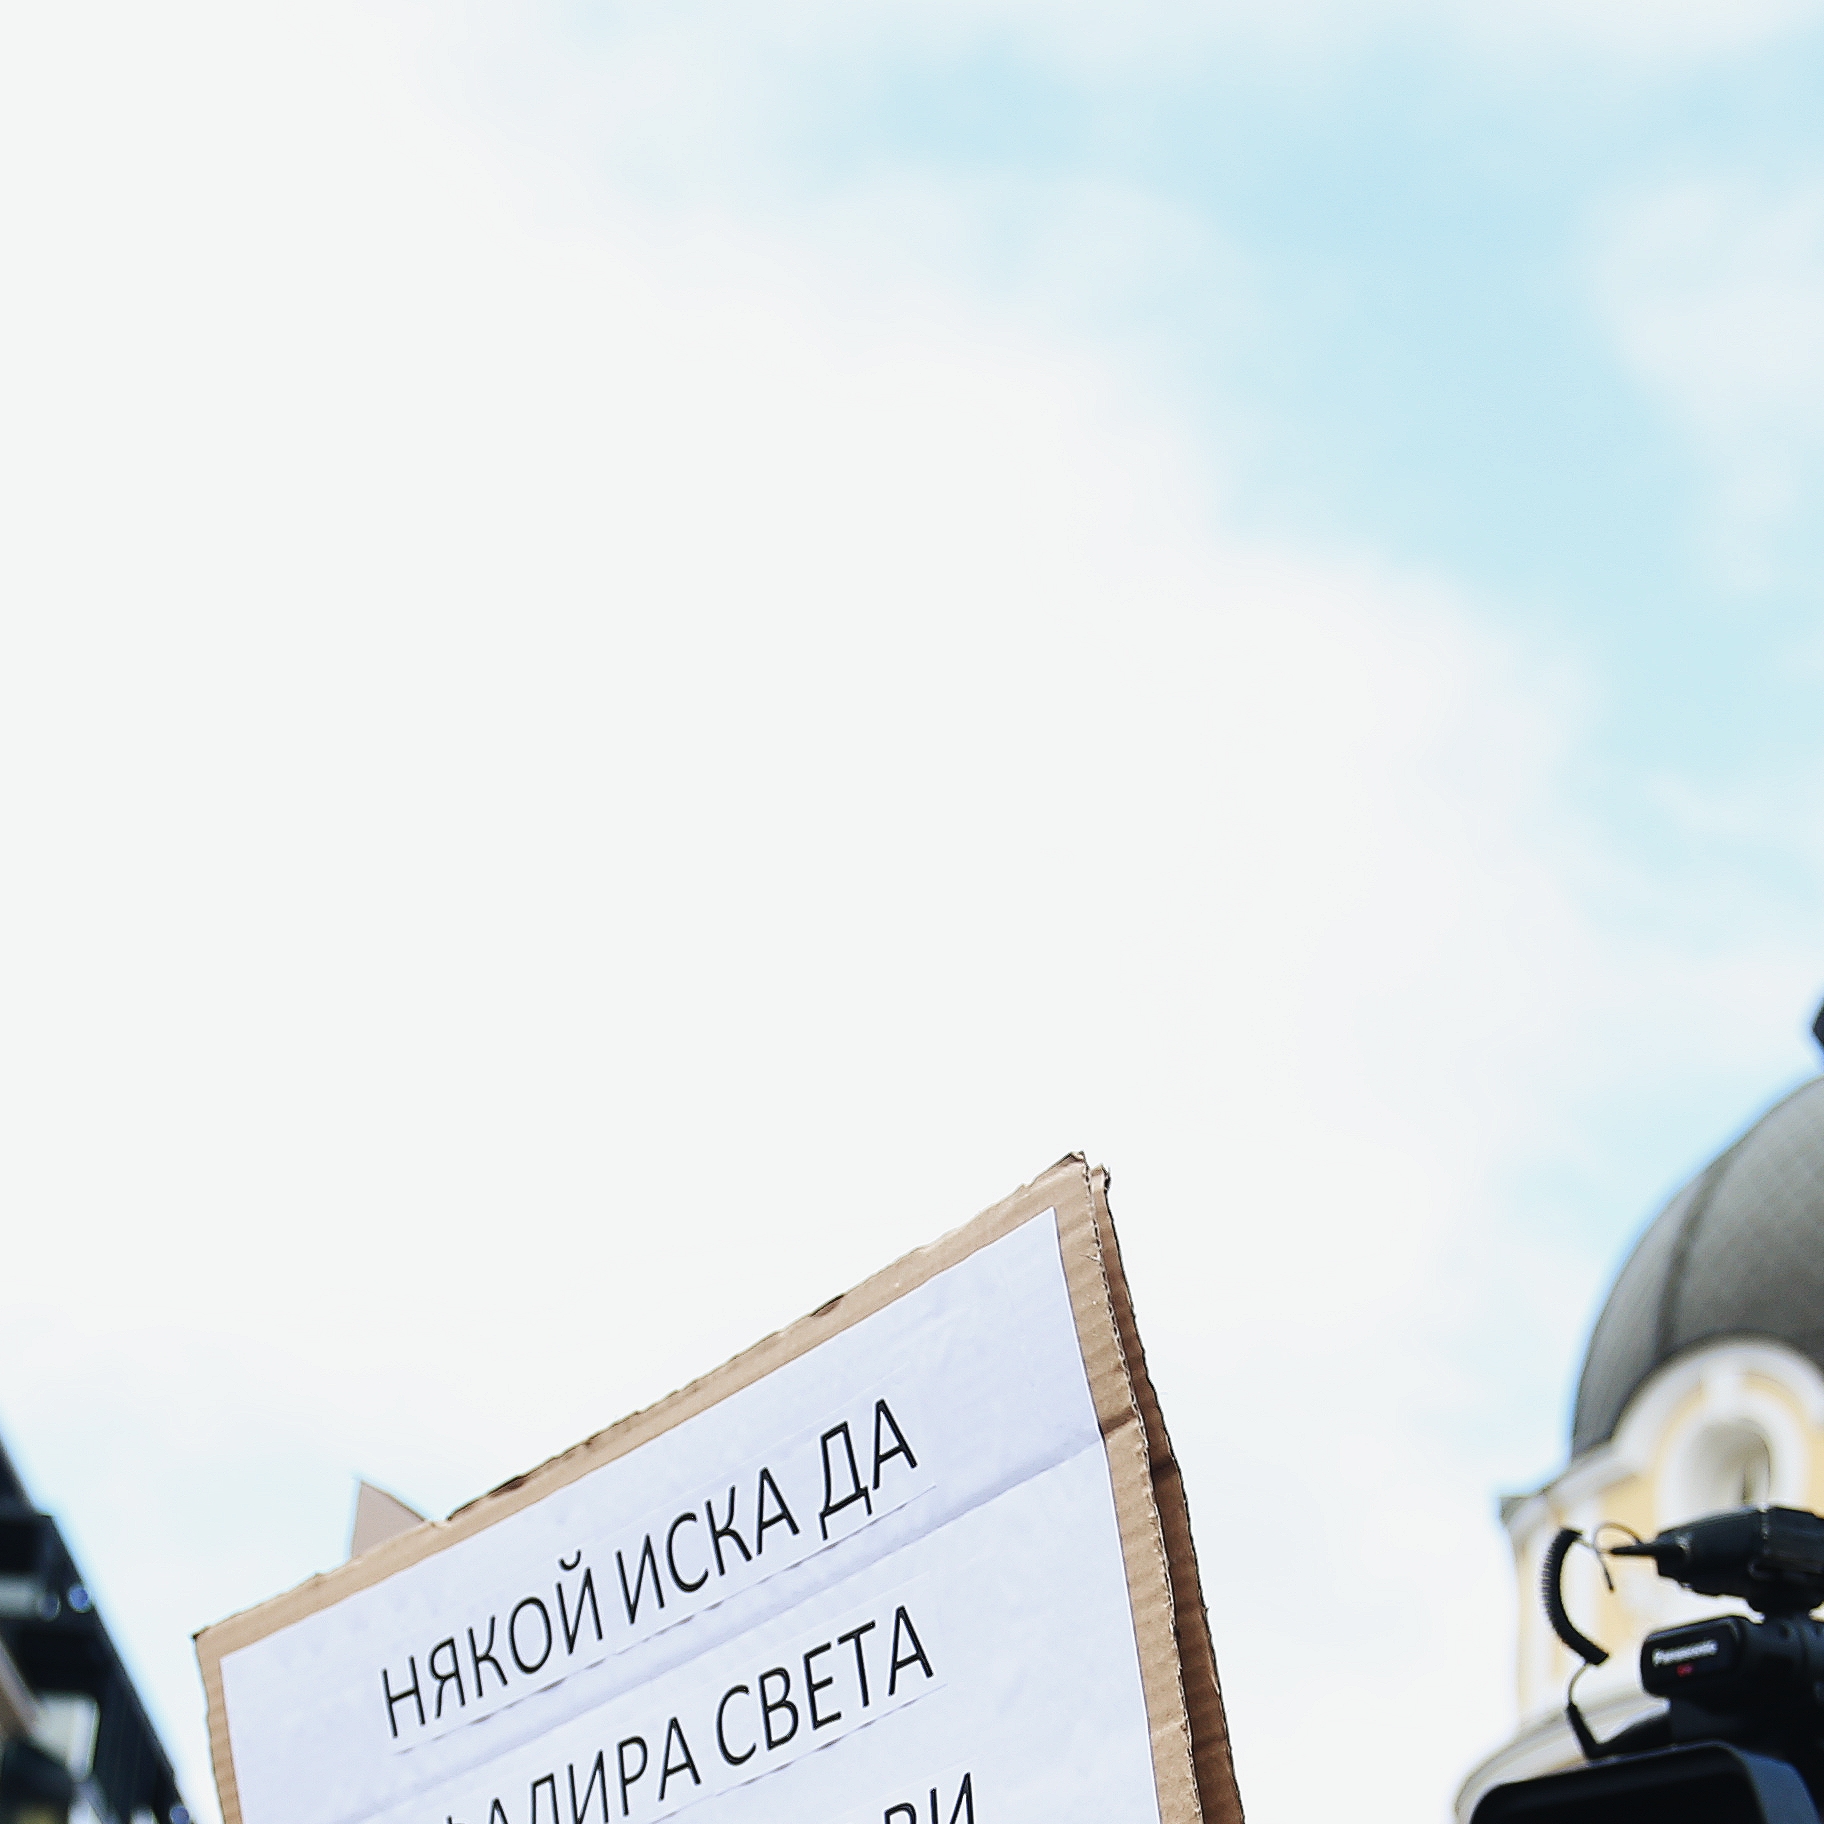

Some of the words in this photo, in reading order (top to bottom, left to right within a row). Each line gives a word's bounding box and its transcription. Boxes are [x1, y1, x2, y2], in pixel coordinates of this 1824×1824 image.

[382, 1549, 604, 1740] НЯКОЙ
[615, 1466, 801, 1626] ИСКА
[818, 1398, 918, 1541] ДА
[716, 1604, 934, 1768] СВЕТА
